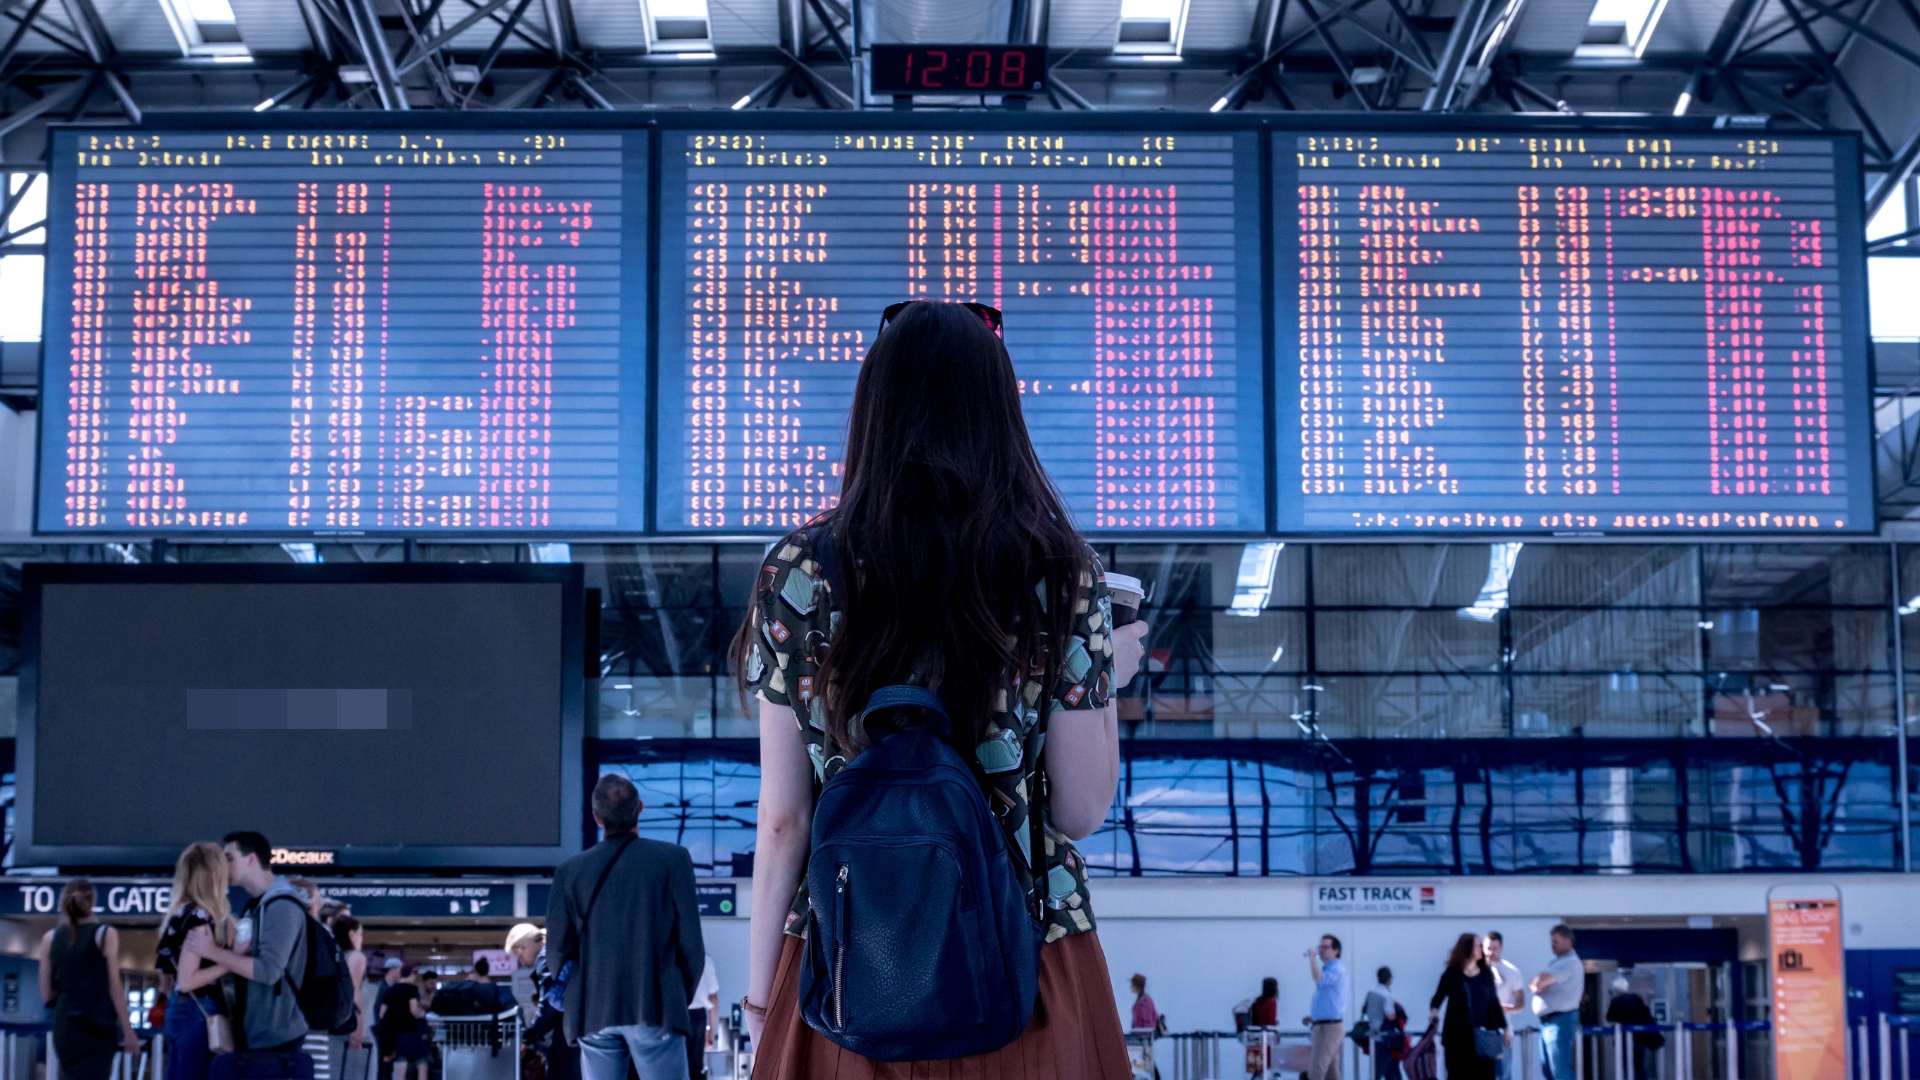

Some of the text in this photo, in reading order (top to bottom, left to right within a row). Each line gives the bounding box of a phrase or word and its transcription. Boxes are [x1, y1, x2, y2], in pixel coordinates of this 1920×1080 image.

[905, 51, 1026, 88] 12:08
[270, 848, 334, 865] Decaux
[19, 886, 54, 912] TO
[108, 886, 172, 913] GATE
[327, 887, 348, 897] YOUR
[349, 887, 387, 897] PASSPORT
[388, 888, 404, 897] AND
[405, 888, 444, 897] BOARDING
[445, 888, 463, 897] PASS
[464, 888, 490, 897] READY
[1319, 887, 1412, 900] FAST TRACK
